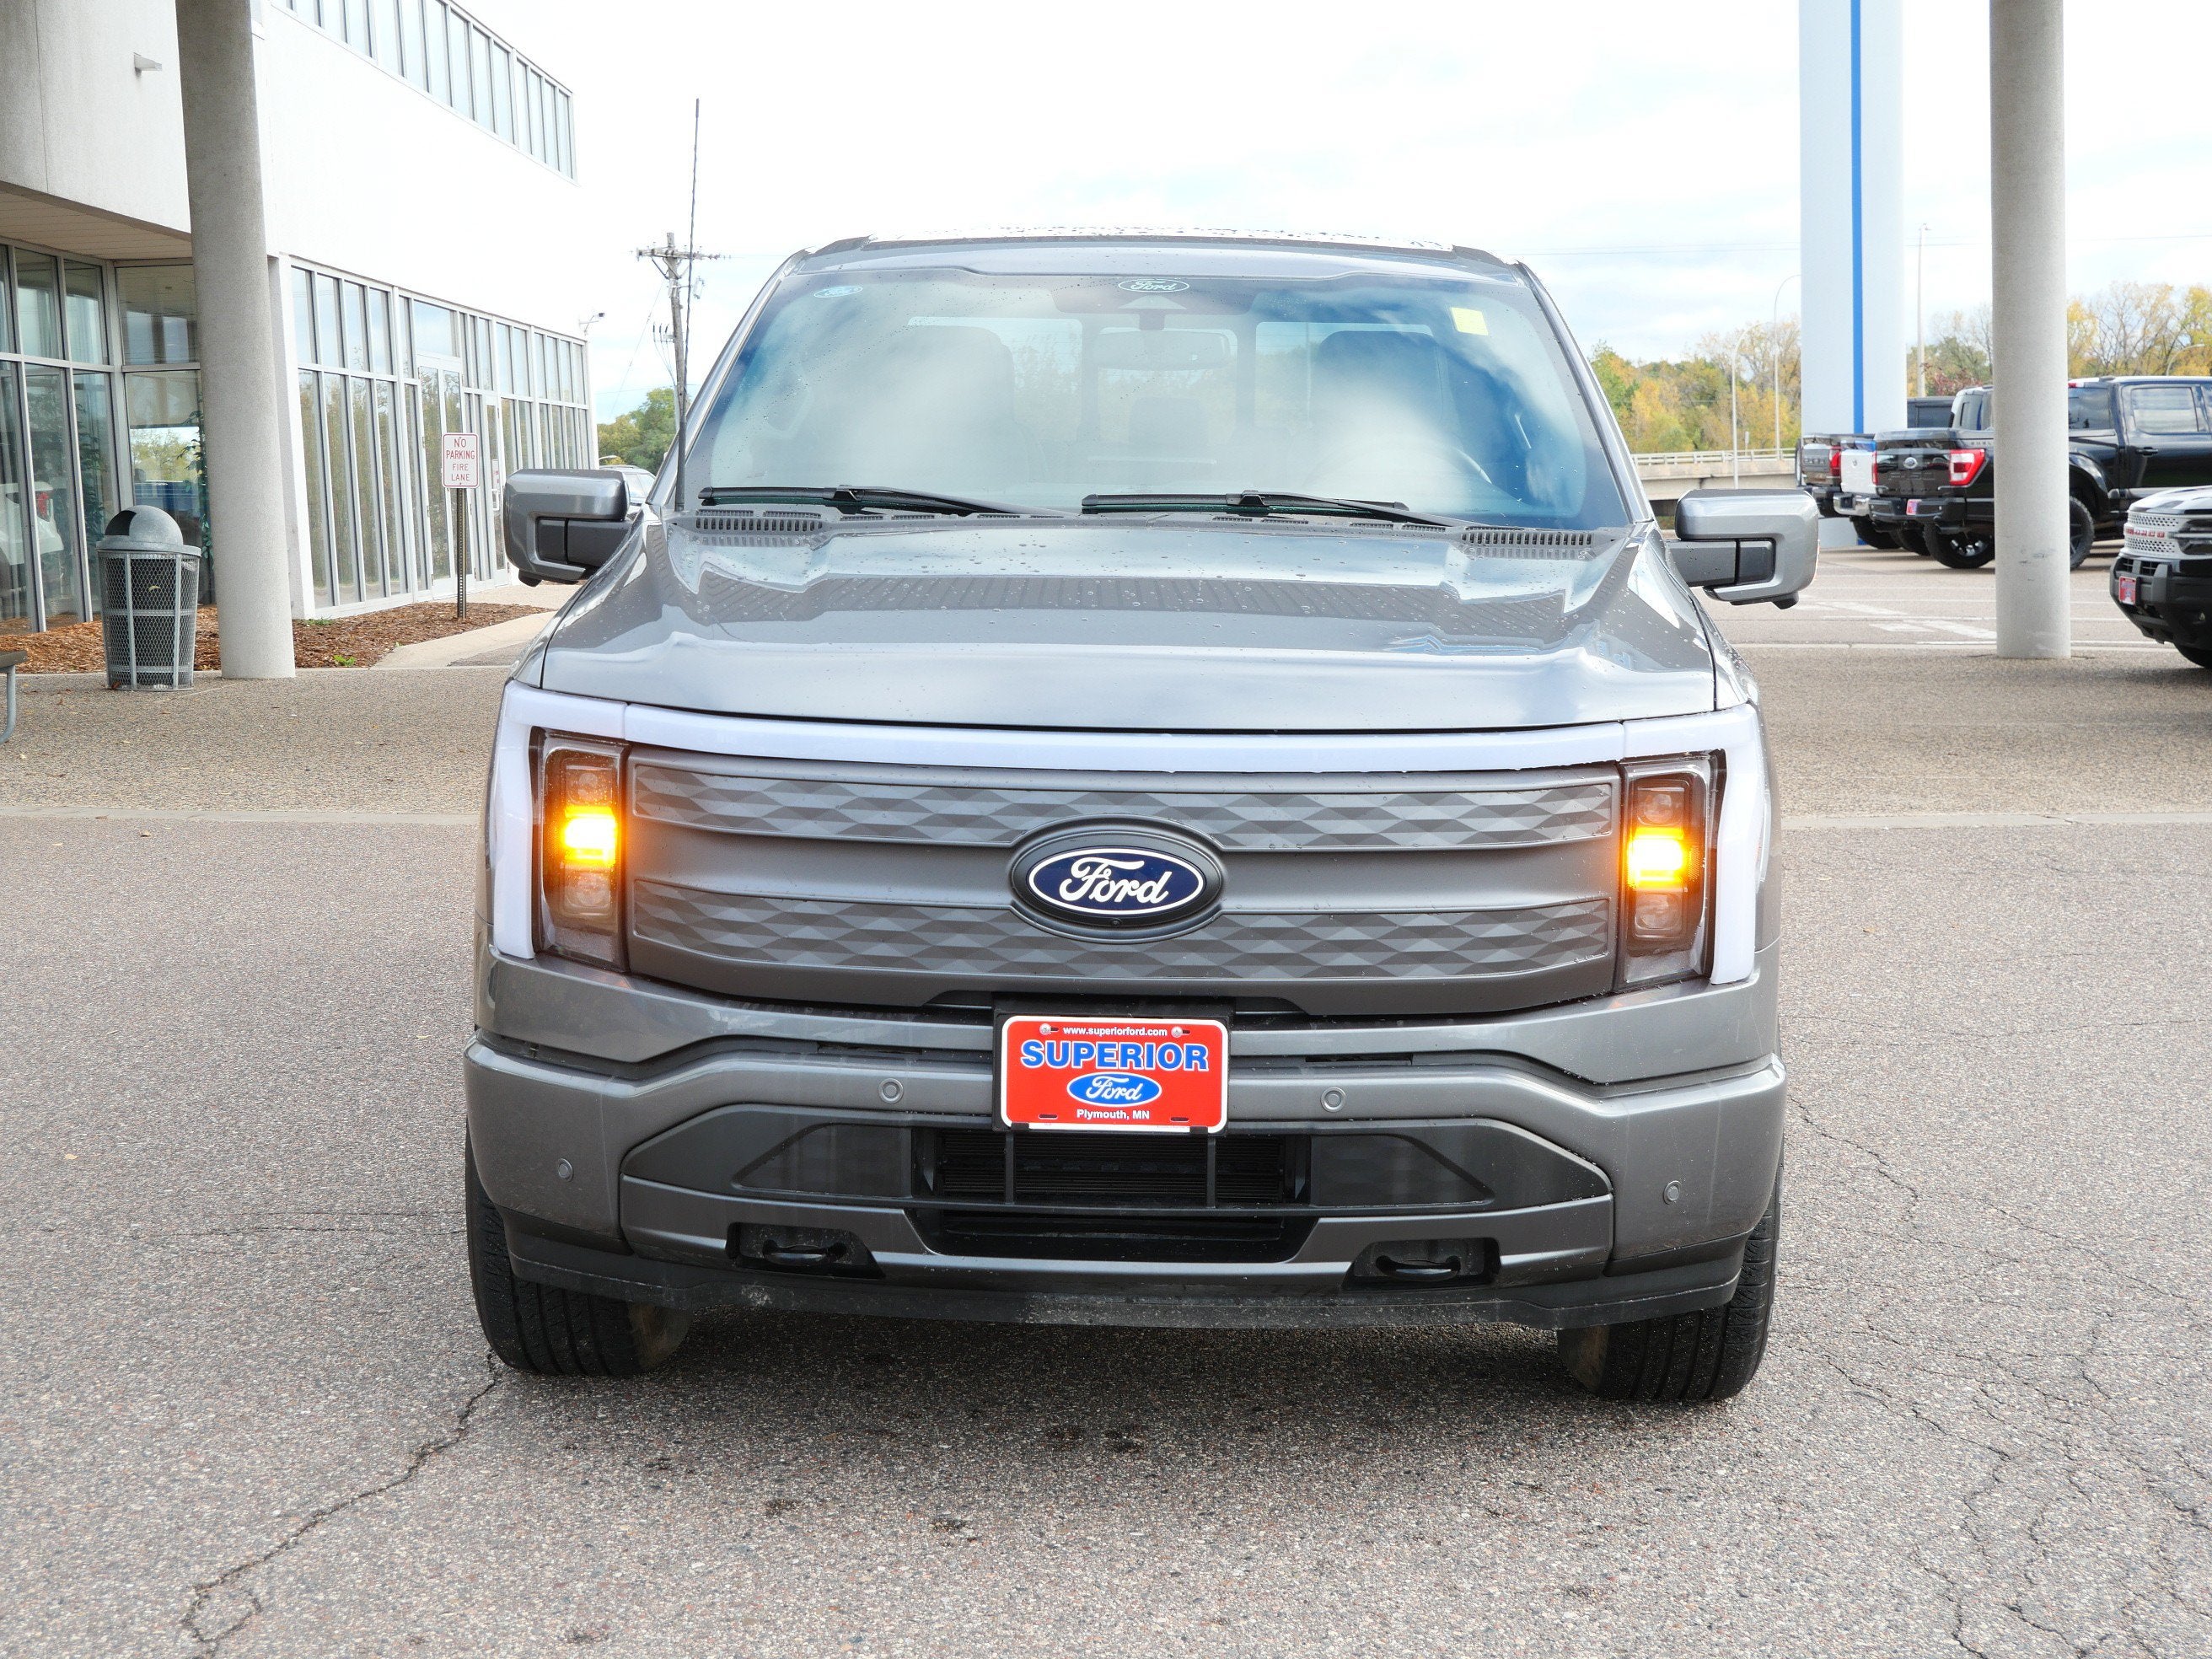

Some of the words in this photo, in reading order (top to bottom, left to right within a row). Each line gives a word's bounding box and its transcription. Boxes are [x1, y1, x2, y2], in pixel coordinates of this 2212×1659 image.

[1130, 281, 1177, 290] Ford
[454, 438, 466, 448] NO
[446, 450, 475, 459] PARKING
[452, 463, 469, 471] FIRE
[451, 473, 470, 481] LANE
[1059, 856, 1172, 904] Ford
[1063, 1026, 1168, 1036] www.superiorford.com
[1020, 1039, 1209, 1071] SUPERIOR
[1086, 1076, 1143, 1101] Ford
[1076, 1109, 1130, 1119] Plymouth,
[1132, 1110, 1150, 1119] MN
